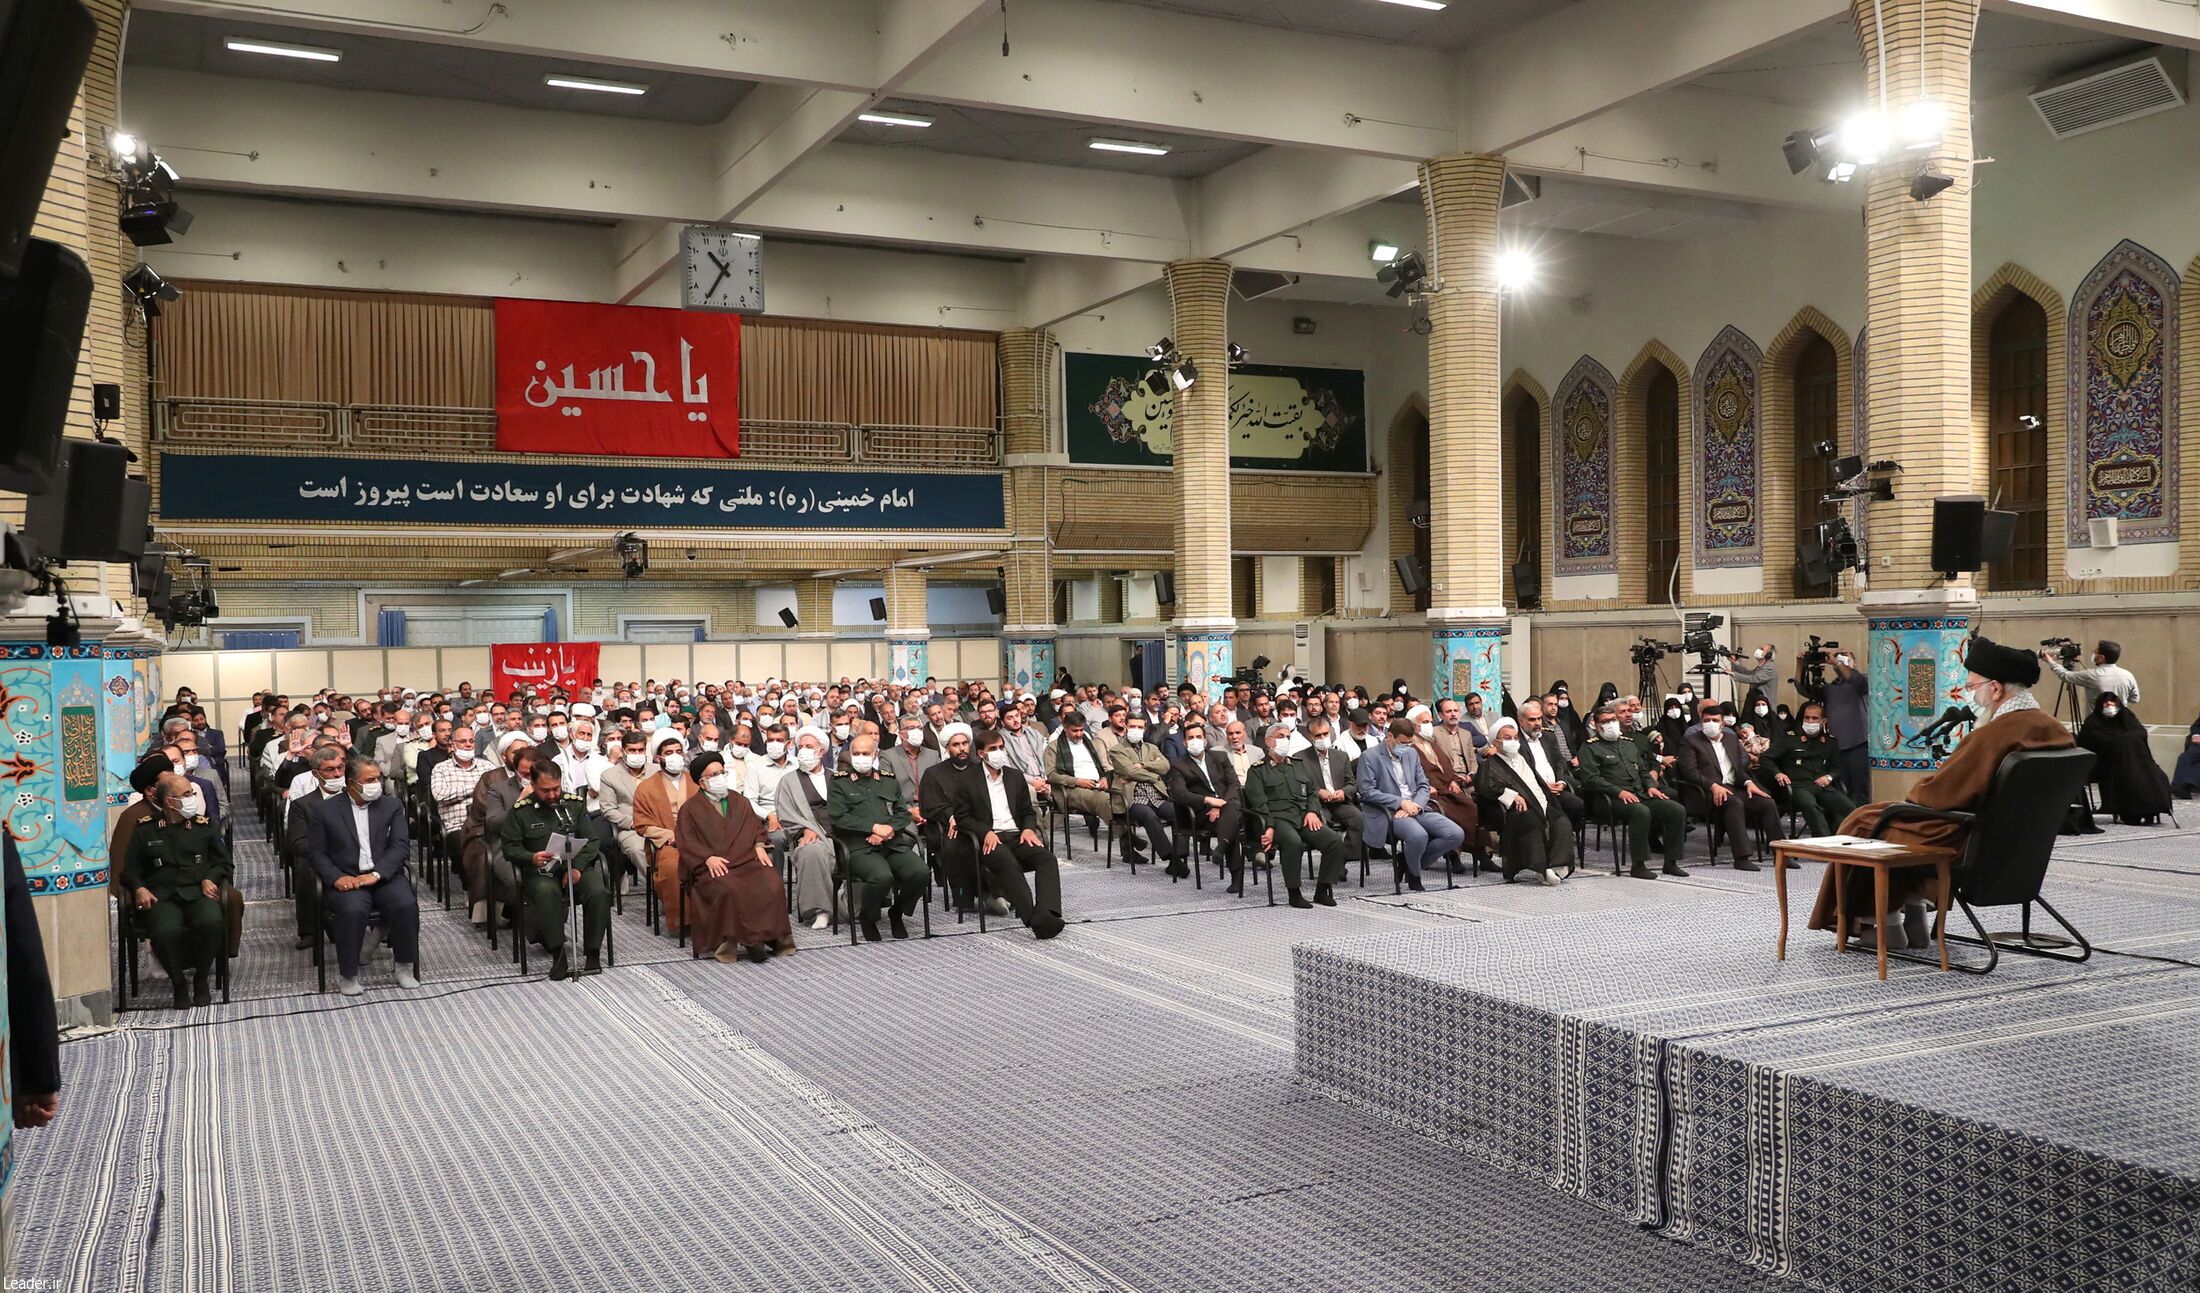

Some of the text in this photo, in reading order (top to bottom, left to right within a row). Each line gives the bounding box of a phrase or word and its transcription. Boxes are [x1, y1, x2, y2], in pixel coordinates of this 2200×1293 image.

[525, 336, 709, 422] یا حسین
[299, 475, 347, 498] است
[354, 481, 411, 507] پیروز
[416, 479, 464, 501] است
[469, 480, 539, 502] سعادت
[543, 481, 563, 510] او
[568, 482, 616, 510] برای
[620, 483, 685, 509] شهادت
[690, 485, 714, 505] که
[719, 485, 763, 513] ملتی
[880, 487, 914, 513] امام
[502, 645, 577, 690] یا زینب
